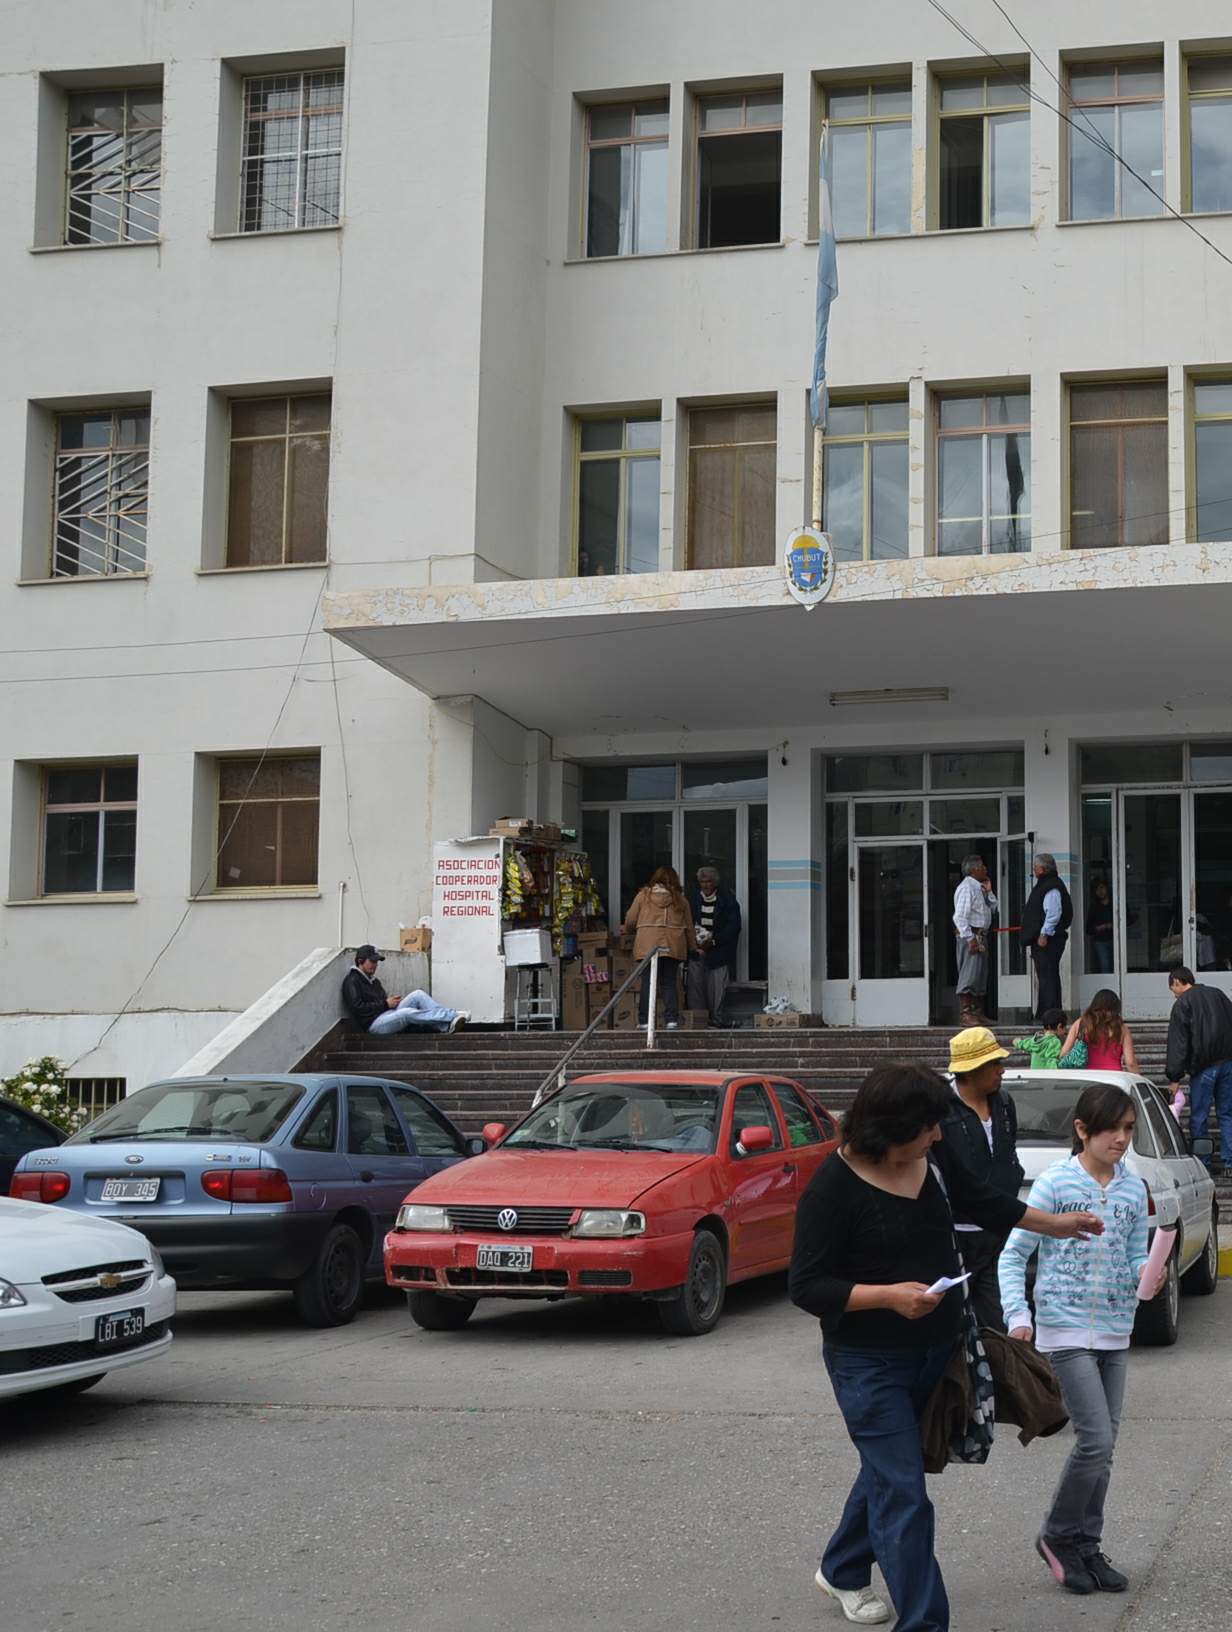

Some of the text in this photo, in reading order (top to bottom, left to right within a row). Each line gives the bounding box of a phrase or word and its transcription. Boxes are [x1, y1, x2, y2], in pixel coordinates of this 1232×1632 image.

[438, 859, 500, 870] ASOCIACION
[435, 875, 501, 886] COOPERADOR
[443, 890, 494, 901] HOSPITAL
[443, 905, 494, 917] REGIONAL
[134, 1182, 157, 1197] 345
[508, 1252, 529, 1268] 221
[98, 1316, 143, 1342] LBI 539
